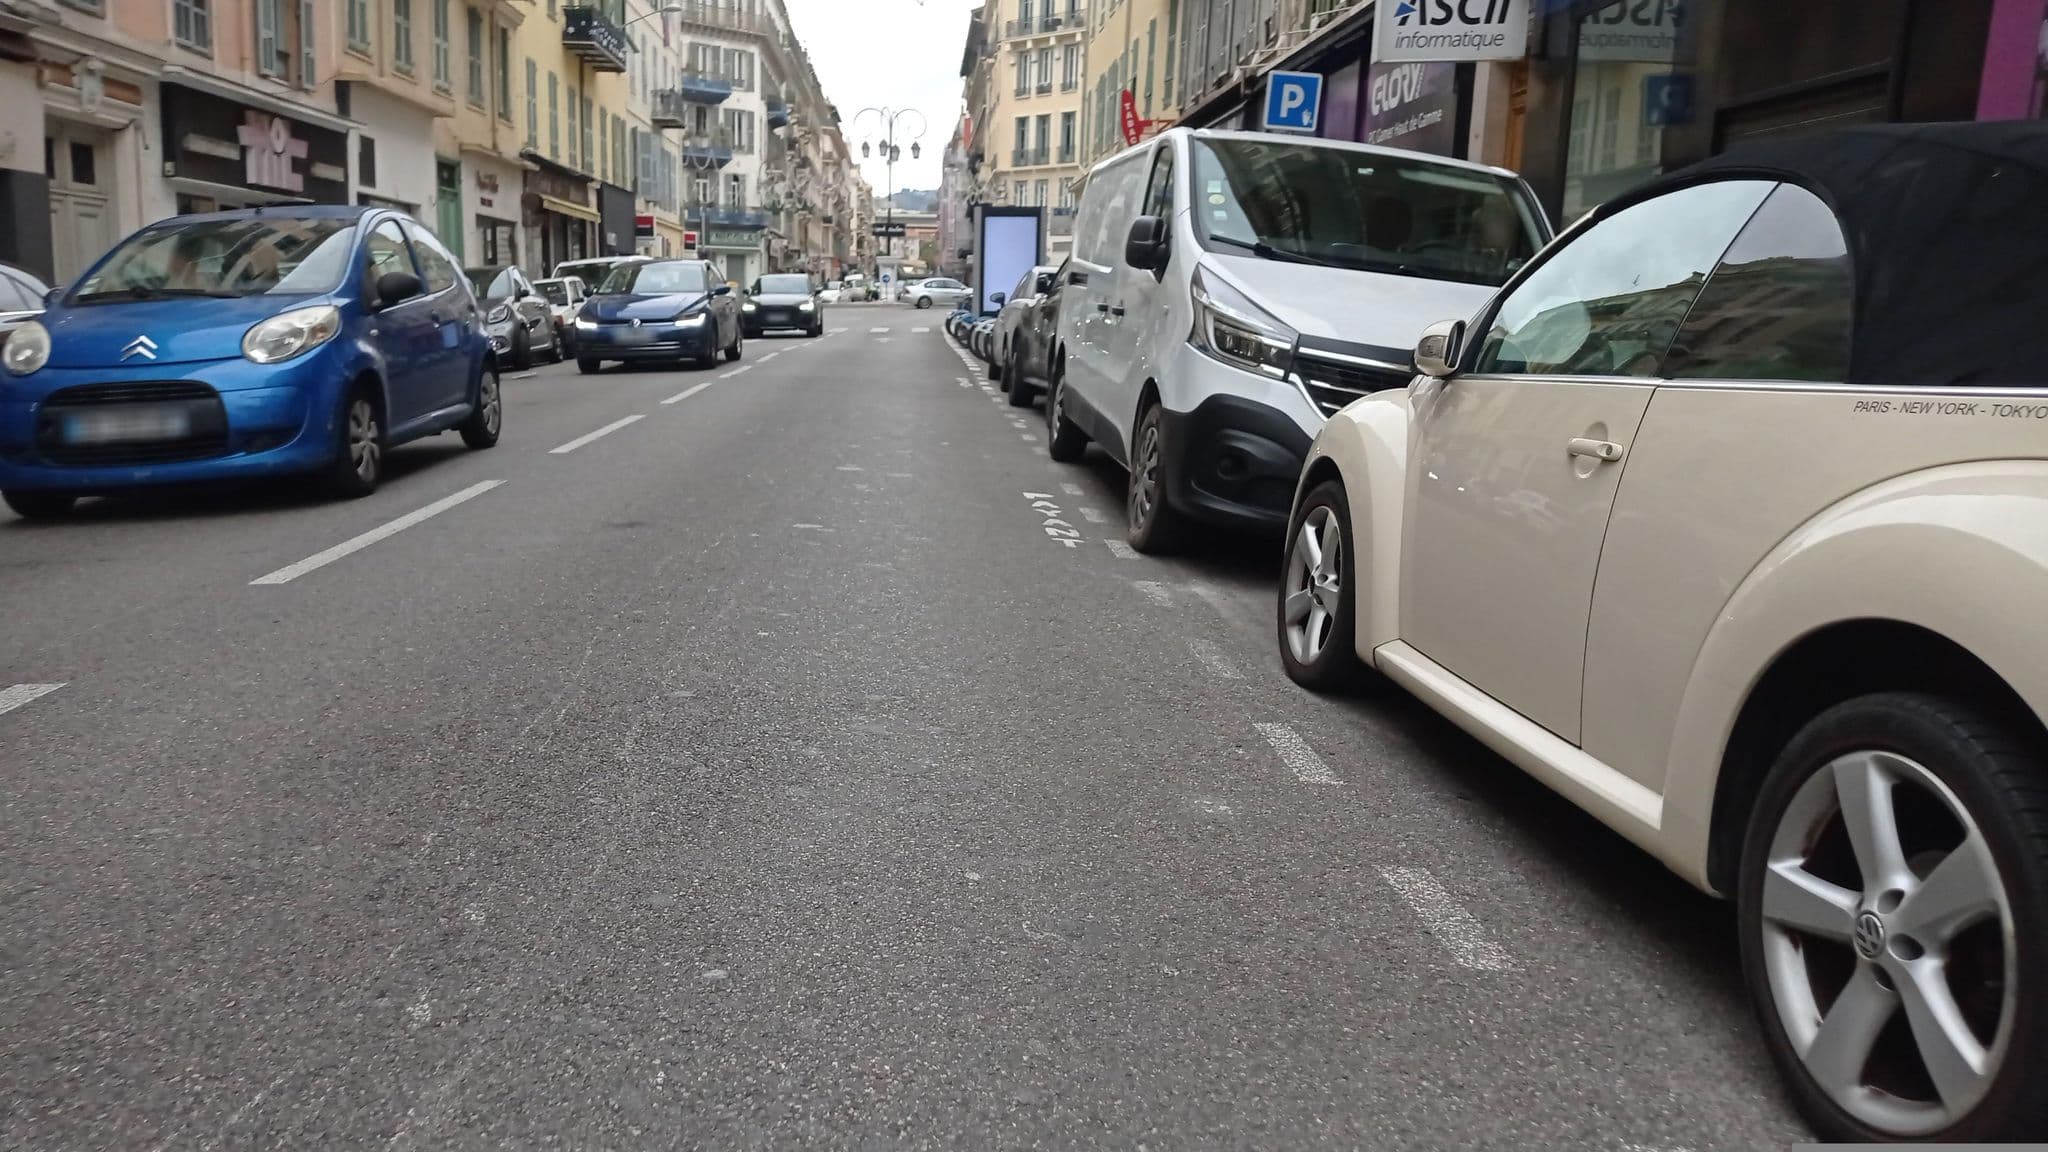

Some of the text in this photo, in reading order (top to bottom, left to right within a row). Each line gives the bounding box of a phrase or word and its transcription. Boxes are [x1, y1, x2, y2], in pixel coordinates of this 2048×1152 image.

[1394, 30, 1505, 50] informatique
[1280, 83, 1305, 118] P
[1123, 102, 1138, 145] TABAC
[1853, 401, 1891, 414] PARIS
[1899, 402, 1935, 415] NEW
[1936, 403, 1978, 417] YORK
[1991, 404, 2048, 419] TOKYO
